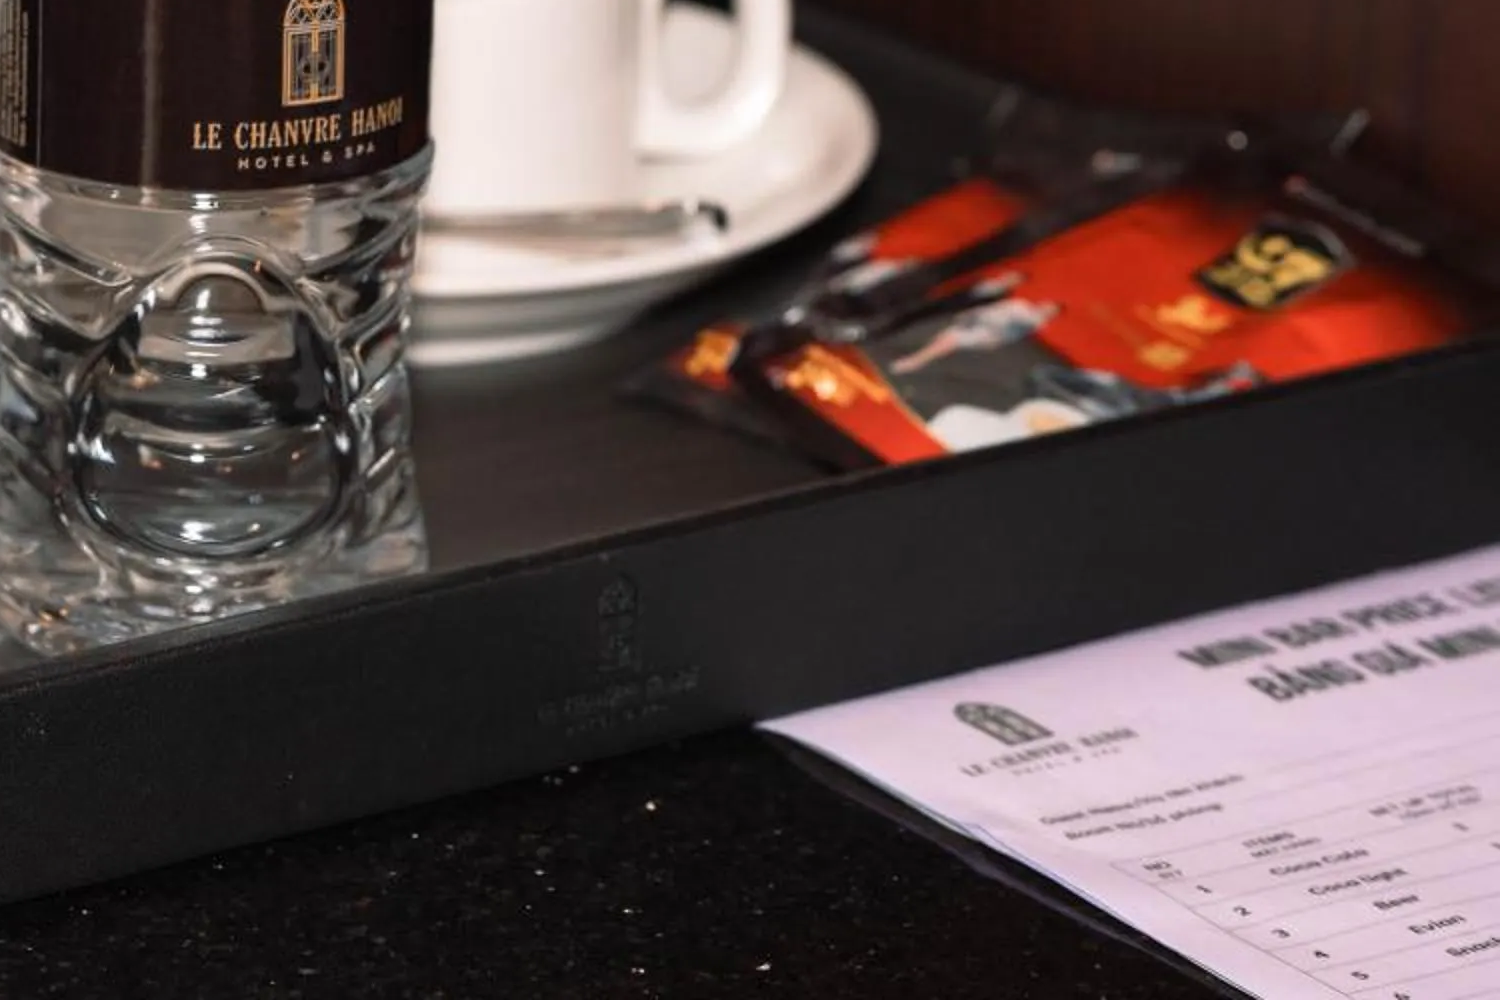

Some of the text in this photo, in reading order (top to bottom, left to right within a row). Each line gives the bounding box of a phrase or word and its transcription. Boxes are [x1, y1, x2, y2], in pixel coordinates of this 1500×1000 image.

[192, 96, 404, 151] LE CHANVRE HANOI
[237, 153, 309, 170] HOTEL
[345, 143, 376, 161] SPA
[1233, 904, 1251, 917] 2
[1271, 927, 1290, 939] 3
[1313, 914, 1467, 959] 4 Evian
[1351, 969, 1370, 981] 5
